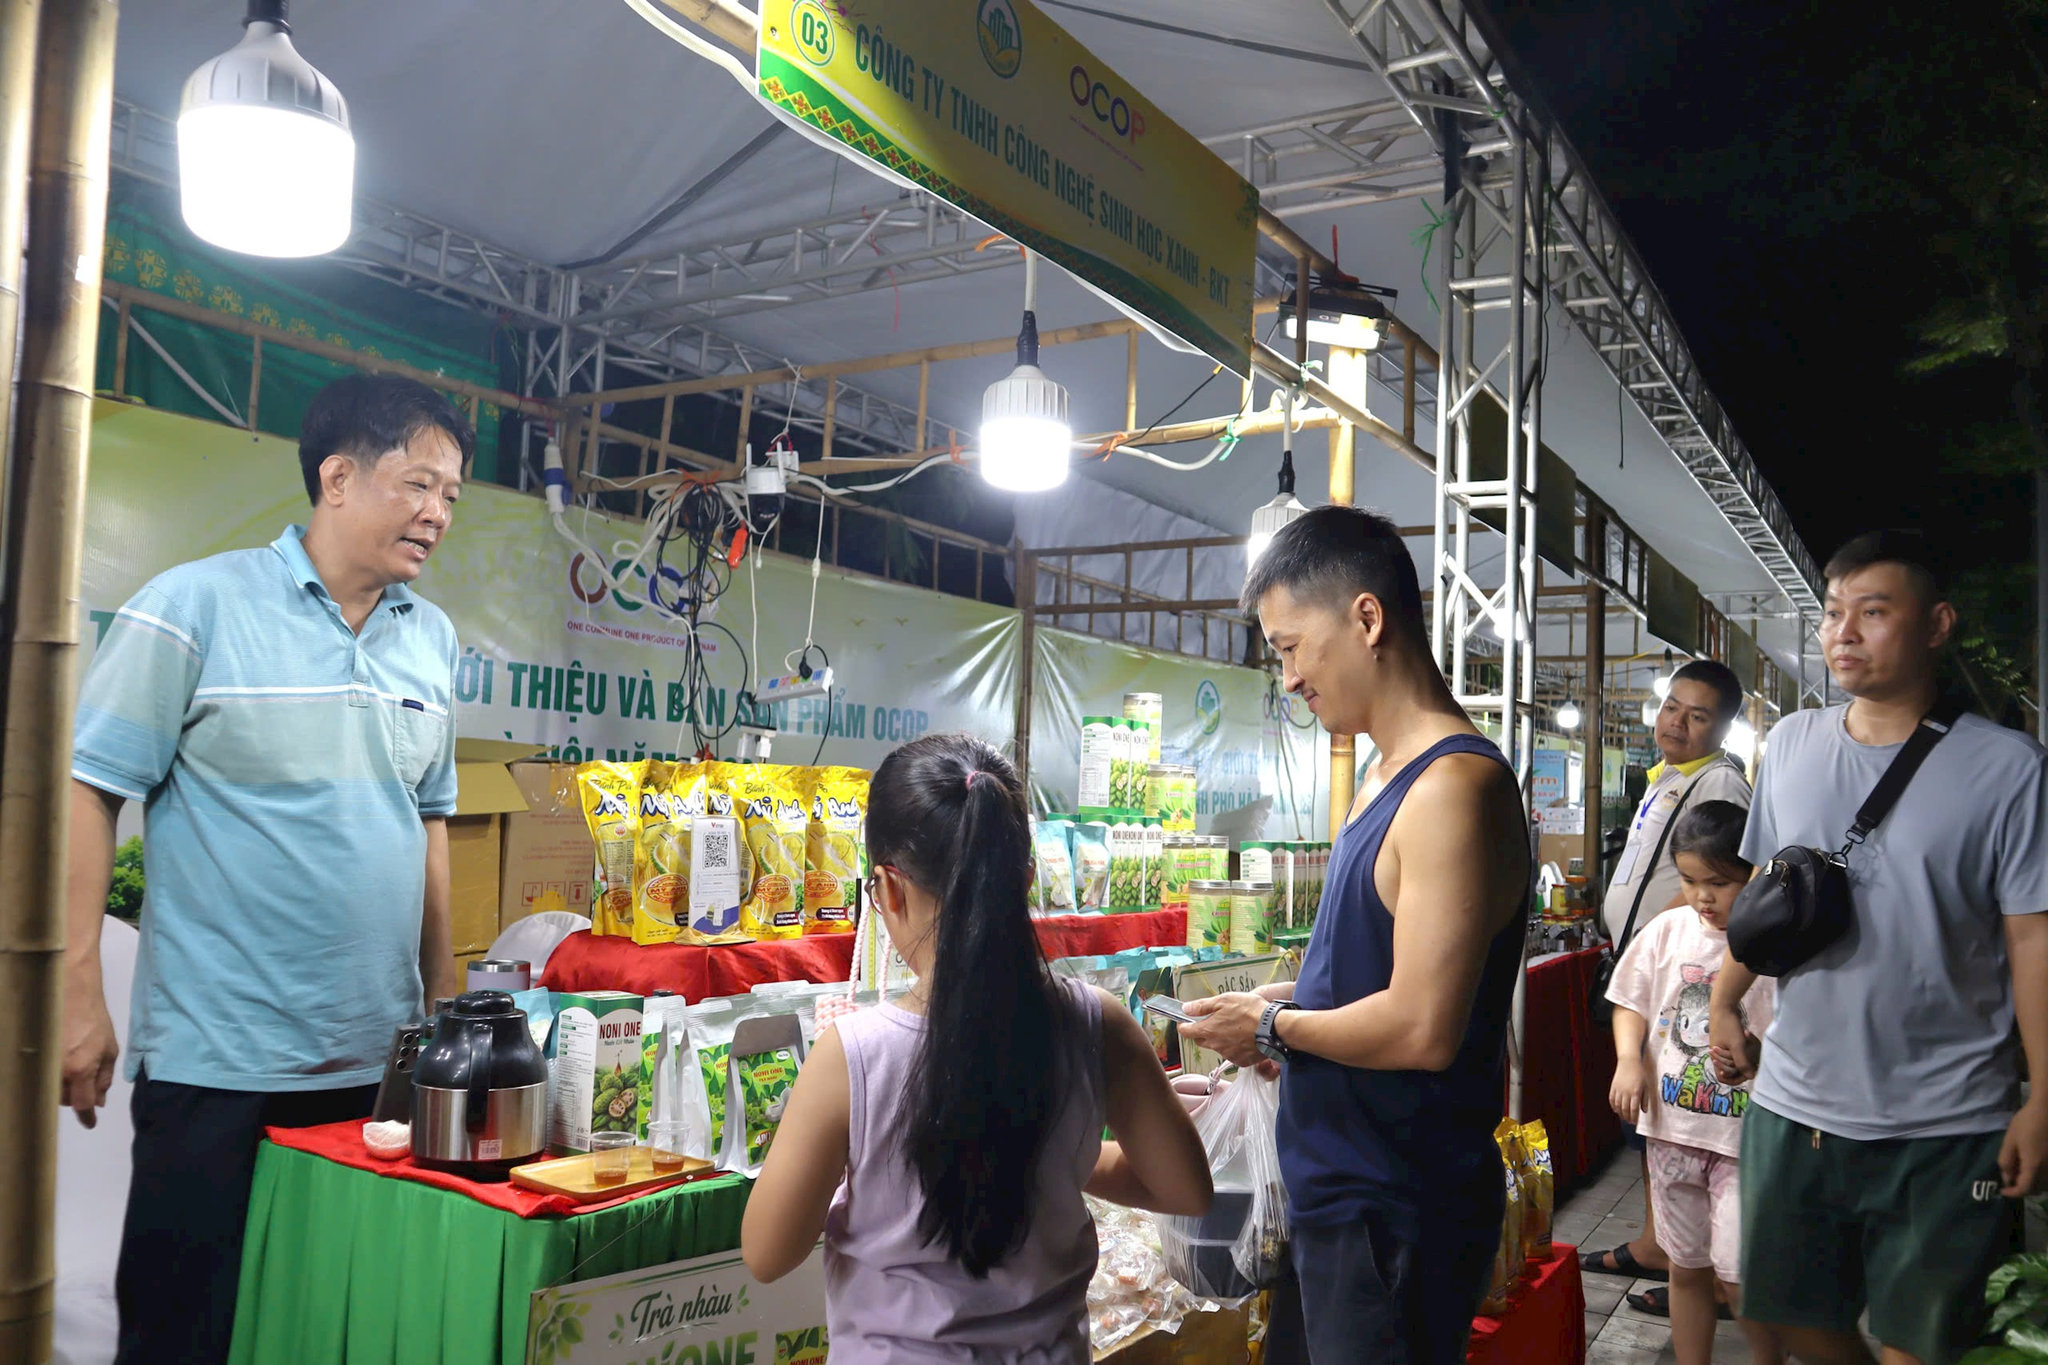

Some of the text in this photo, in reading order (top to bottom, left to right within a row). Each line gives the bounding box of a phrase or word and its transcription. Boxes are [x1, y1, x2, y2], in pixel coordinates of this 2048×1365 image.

[801, 11, 829, 55] 03
[1070, 65, 1146, 145] OCOP
[855, 23, 915, 102] CÔNG
[922, 66, 945, 120] TY
[951, 86, 998, 156] TNHH
[1004, 125, 1049, 190] CÔNG
[1054, 158, 1095, 227] NGHỆ
[1100, 190, 1133, 245] SINH
[1136, 215, 1162, 265] HỌC
[1166, 235, 1199, 288] XANH
[1209, 265, 1230, 309] BKT
[567, 620, 584, 632] ONE
[624, 631, 640, 641] ONE
[676, 638, 686, 647] OF
[455, 646, 494, 705] ỚI
[507, 660, 607, 723] THIỆU
[617, 668, 656, 720] VÀ
[796, 687, 866, 739] PHẨM
[873, 706, 929, 742] OCOP
[600, 1021, 642, 1040] NONI ONE
[631, 1284, 733, 1344] Trà nhàu
